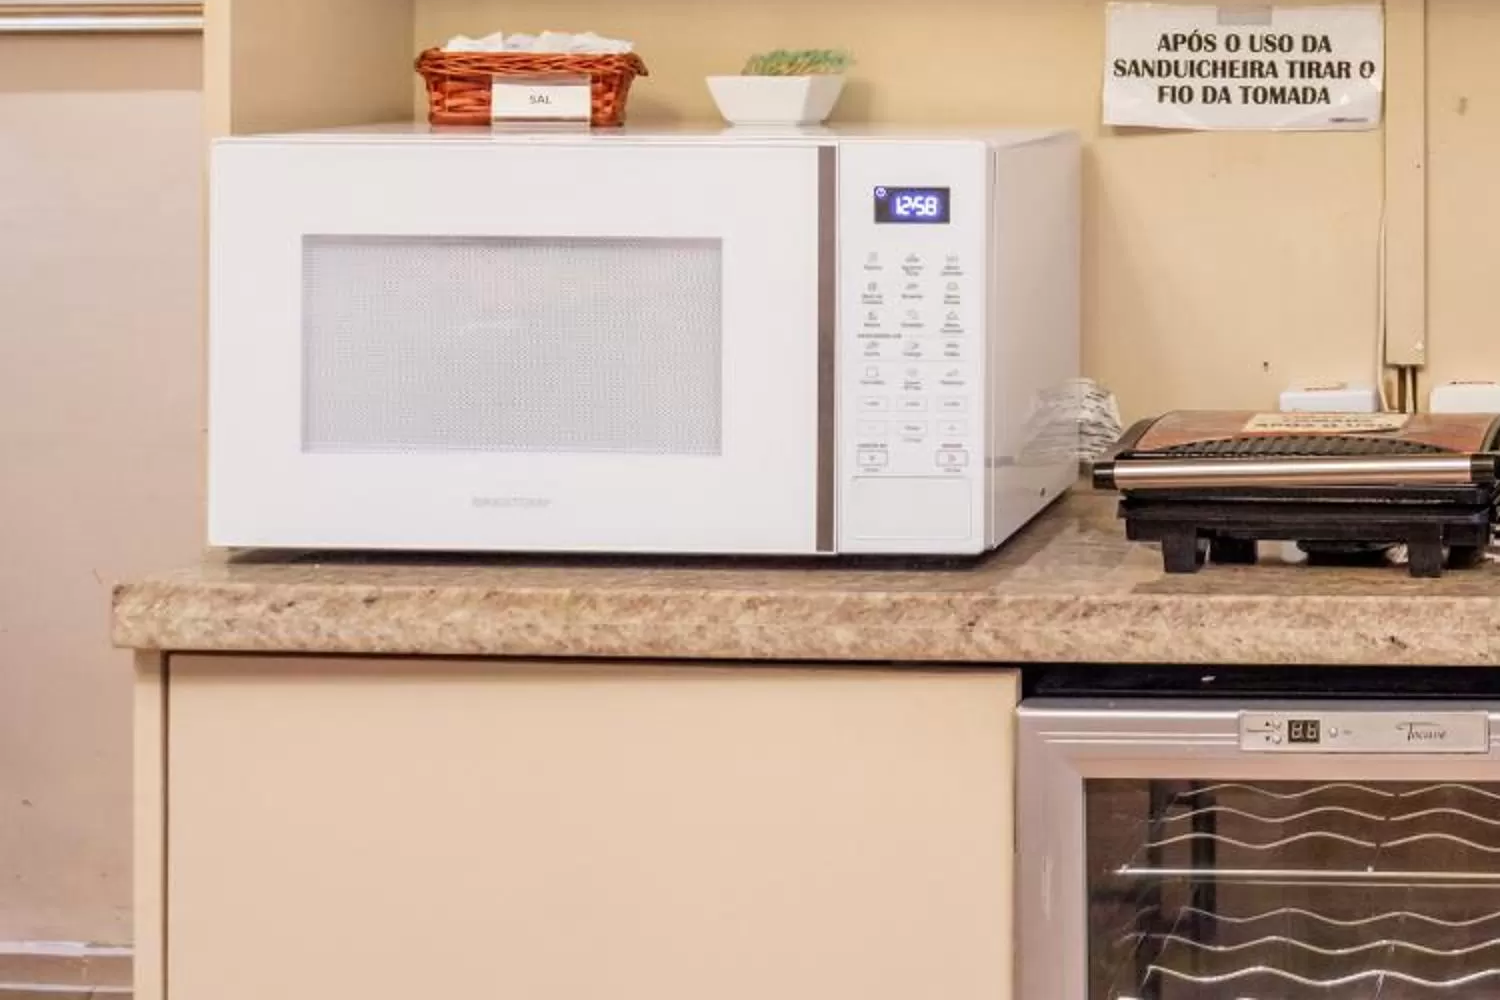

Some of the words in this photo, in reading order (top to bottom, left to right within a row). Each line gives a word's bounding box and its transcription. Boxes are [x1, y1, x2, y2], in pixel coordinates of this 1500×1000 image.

[1157, 29, 1217, 53] APÓS
[1225, 34, 1240, 53] O
[1250, 34, 1294, 53] USO
[1302, 35, 1332, 53] DA
[1113, 59, 1279, 79] SANDUICHEIRA
[1285, 61, 1351, 79] TIRAR
[1359, 61, 1375, 79] O
[529, 95, 552, 105] SAL
[1157, 86, 1194, 104] FIO
[1202, 86, 1232, 104] DA
[1239, 86, 1331, 104] TOMADA
